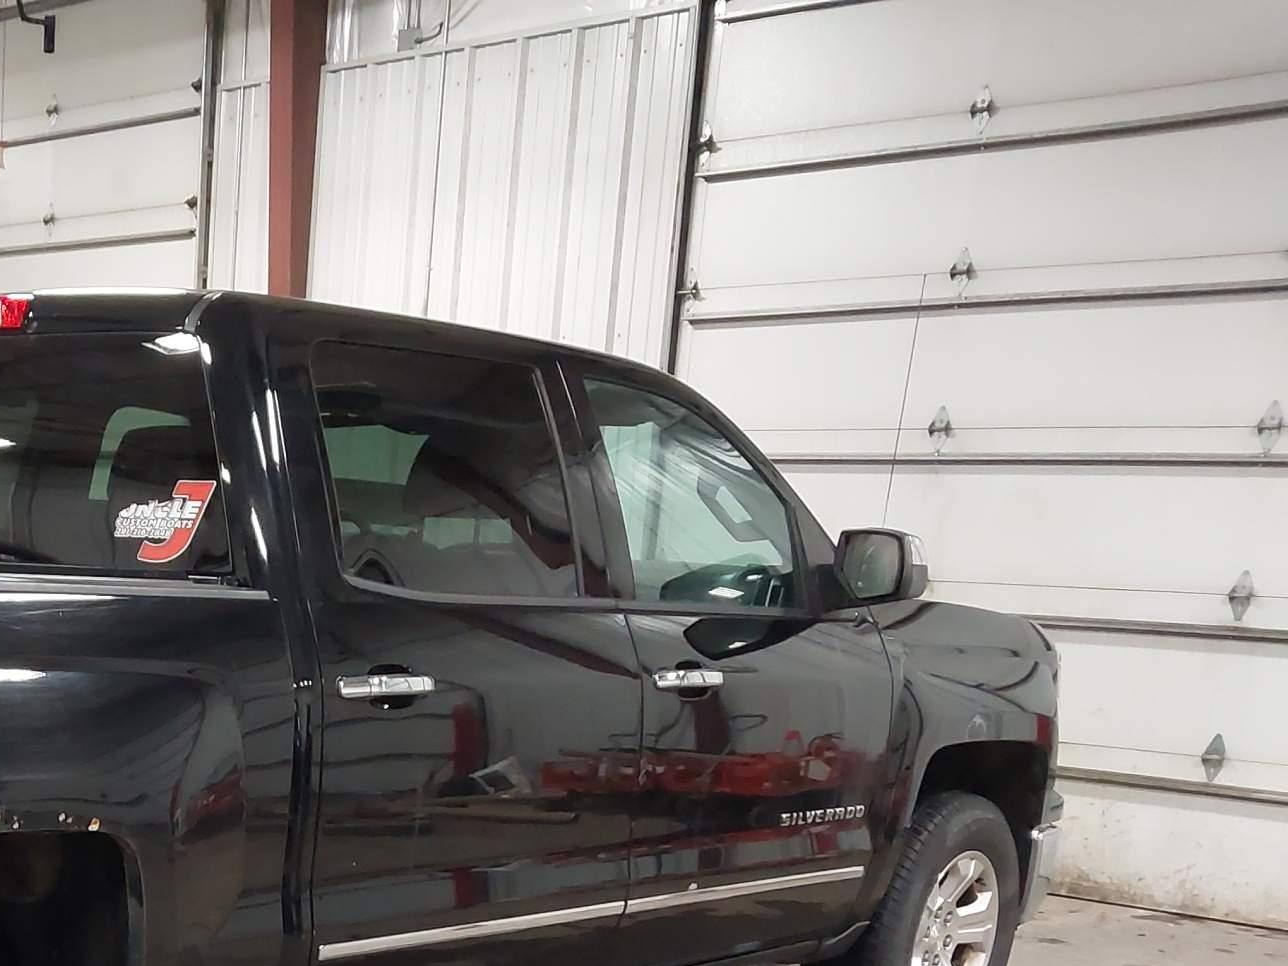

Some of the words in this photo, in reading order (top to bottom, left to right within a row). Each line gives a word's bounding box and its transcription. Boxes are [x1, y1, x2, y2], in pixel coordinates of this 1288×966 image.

[118, 499, 203, 519] UNCLE
[116, 519, 157, 529] CUSTOM
[160, 519, 194, 529] BOATS
[779, 805, 865, 827] SILVERADO
